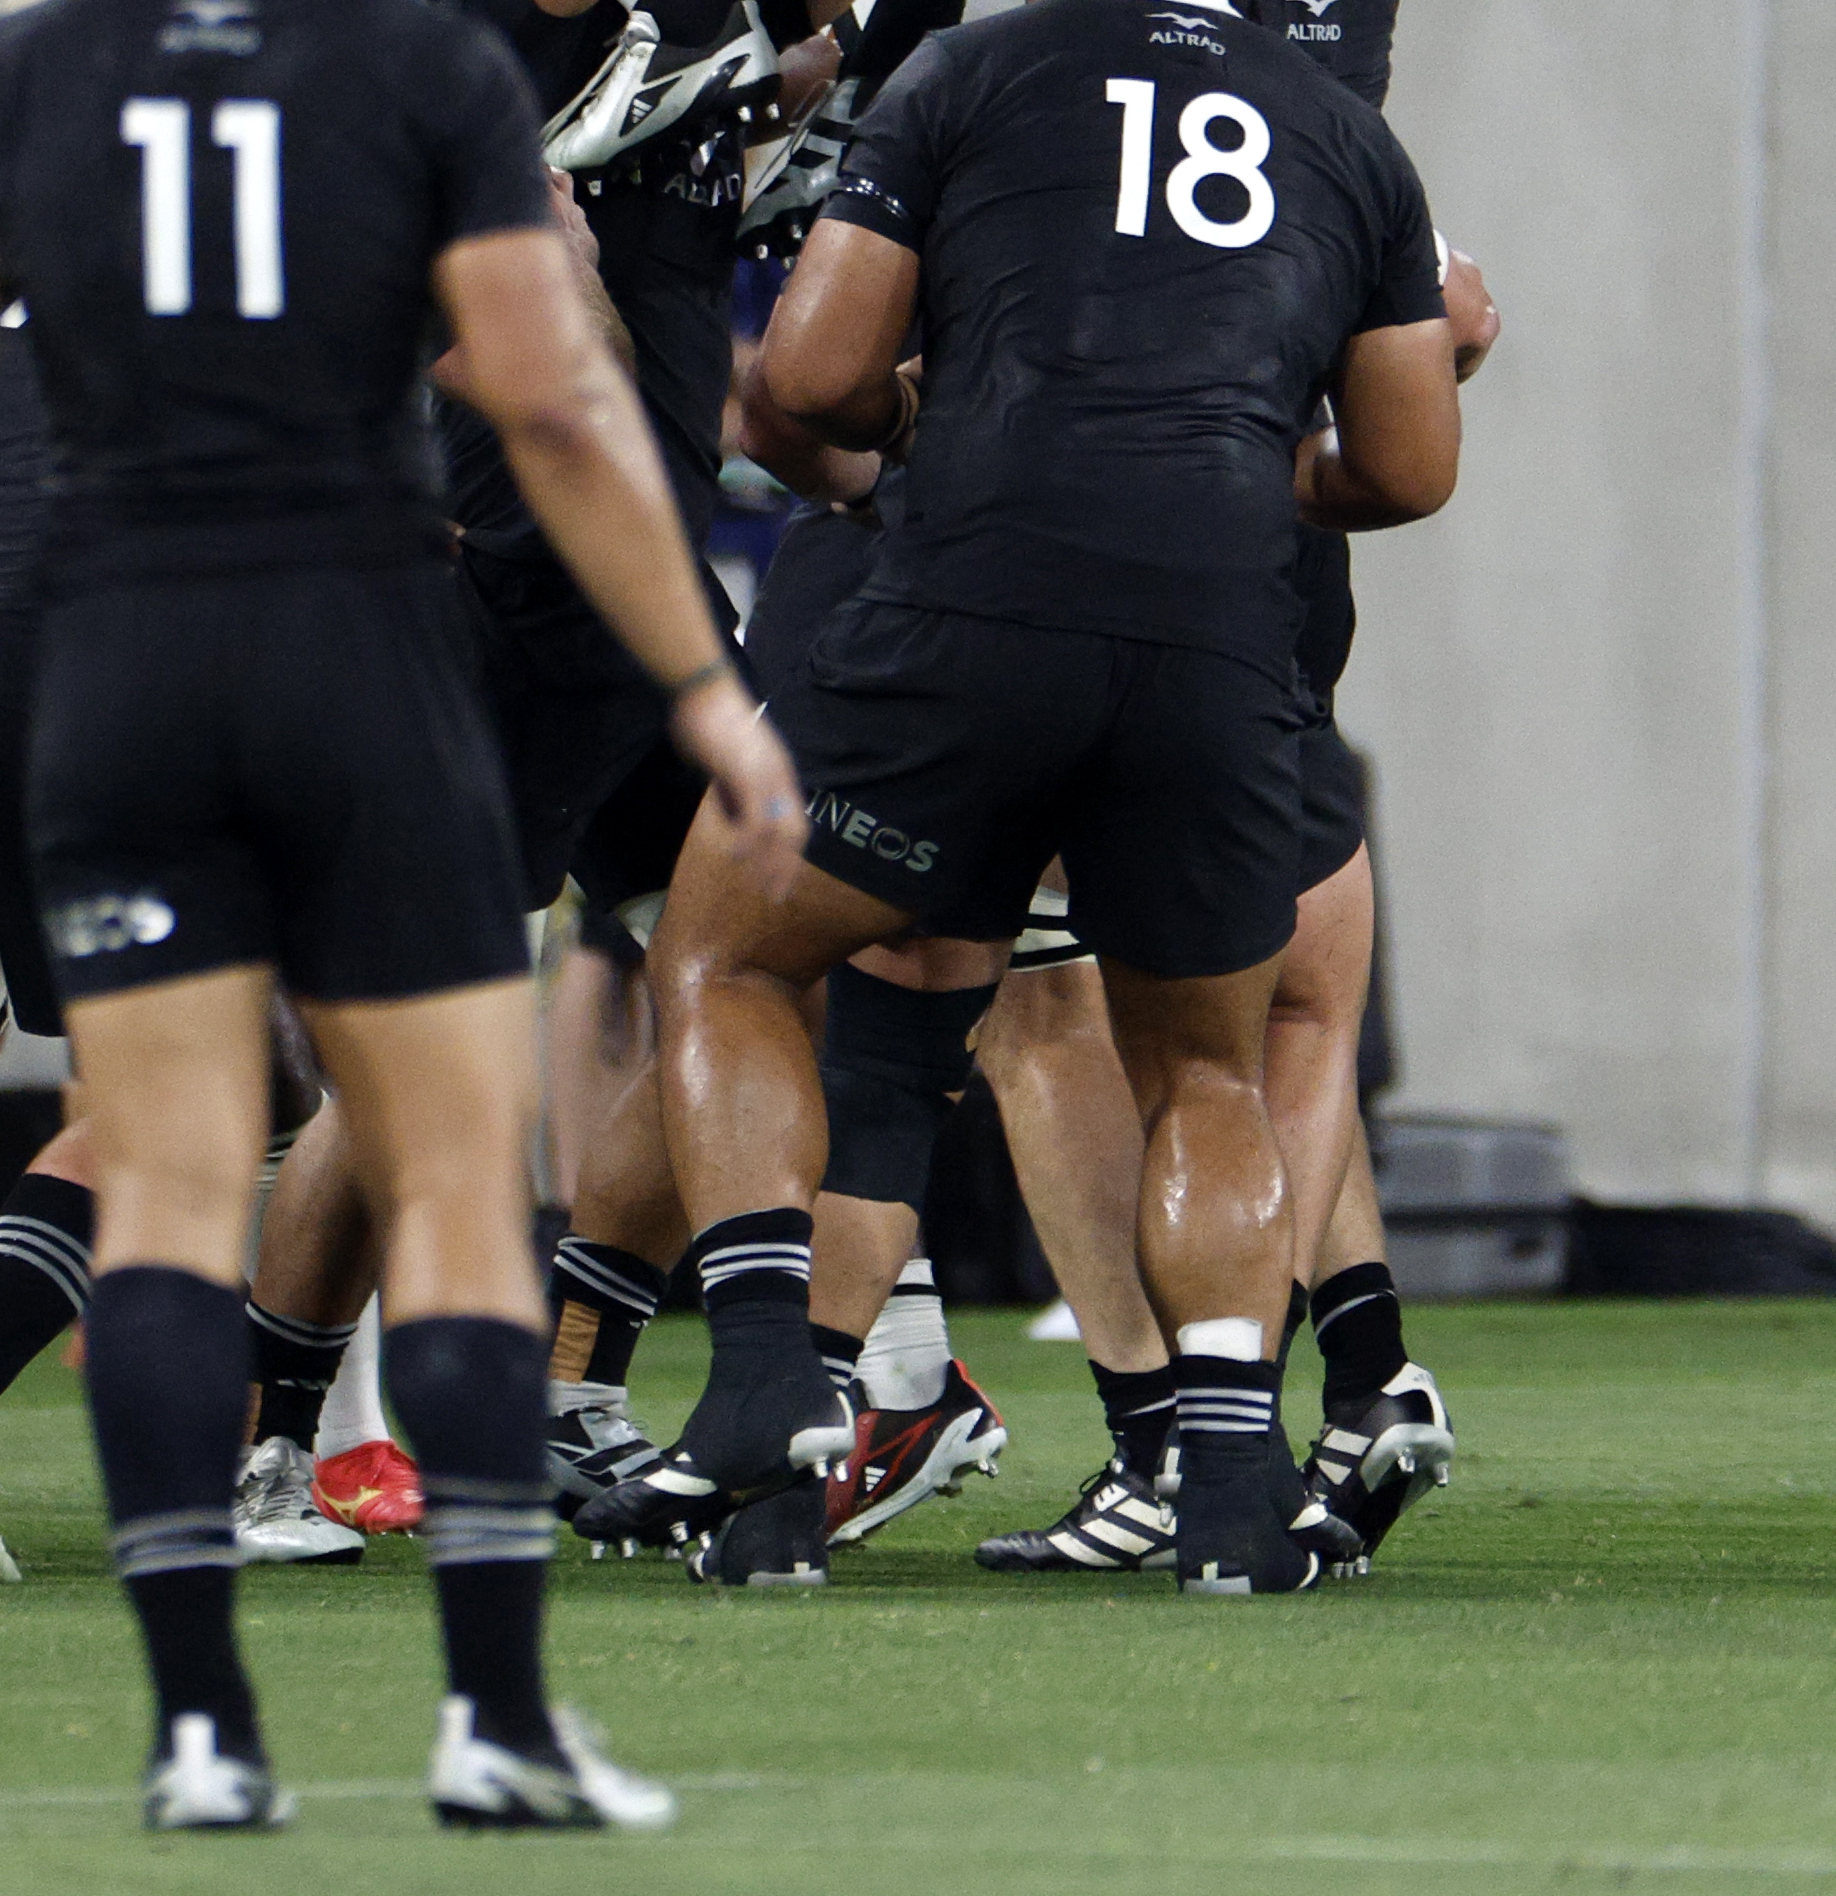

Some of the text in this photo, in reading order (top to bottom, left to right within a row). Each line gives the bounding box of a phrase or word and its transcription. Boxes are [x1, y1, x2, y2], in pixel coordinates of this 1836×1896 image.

[1148, 30, 1227, 56] ALTRAD
[1286, 23, 1342, 42] ALTRAD
[1105, 77, 1278, 249] 18
[121, 98, 286, 320] 11
[804, 789, 940, 872] INEOS
